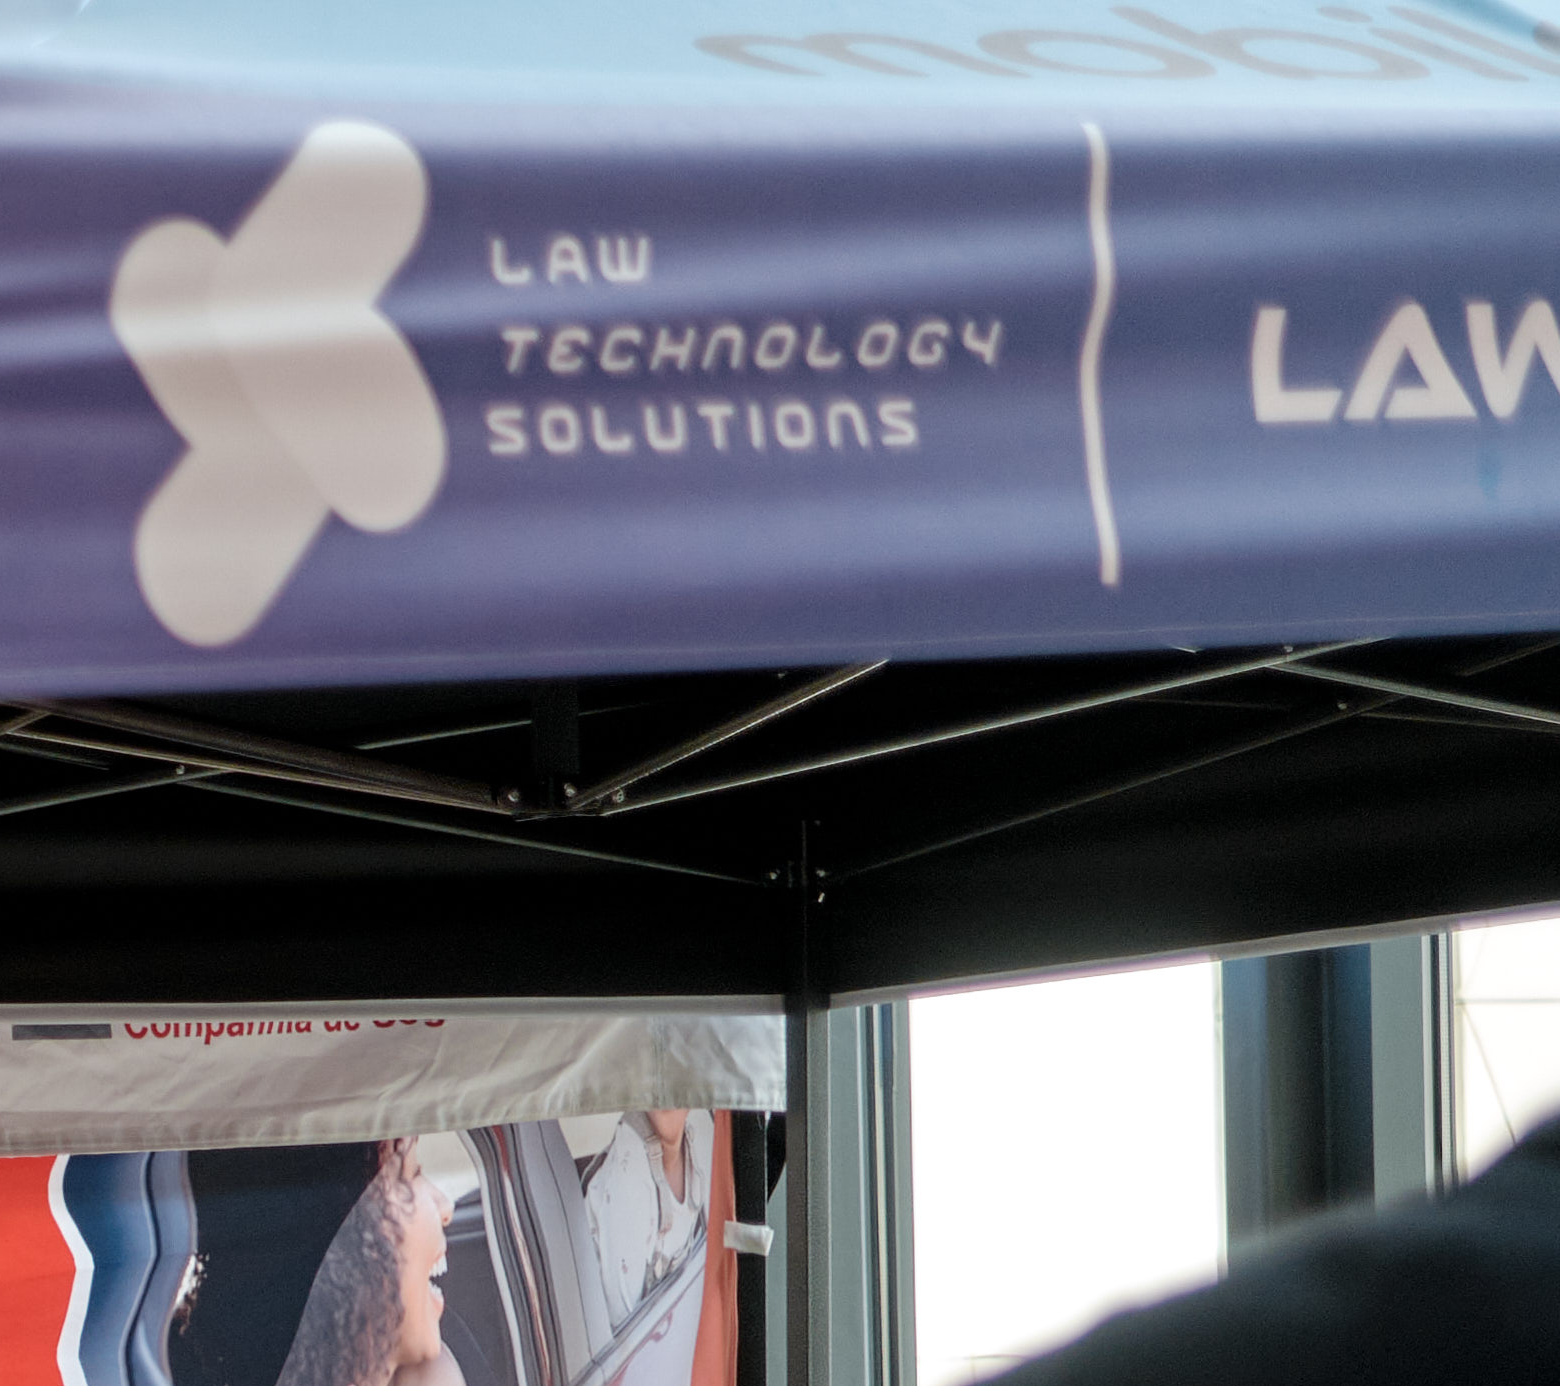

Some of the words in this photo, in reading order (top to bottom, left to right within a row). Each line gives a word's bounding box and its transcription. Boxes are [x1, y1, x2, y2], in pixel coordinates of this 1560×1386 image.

[486, 236, 652, 286] LAW
[499, 316, 1007, 374] TECHNOLOGY
[484, 401, 921, 456] SOLUTIONS
